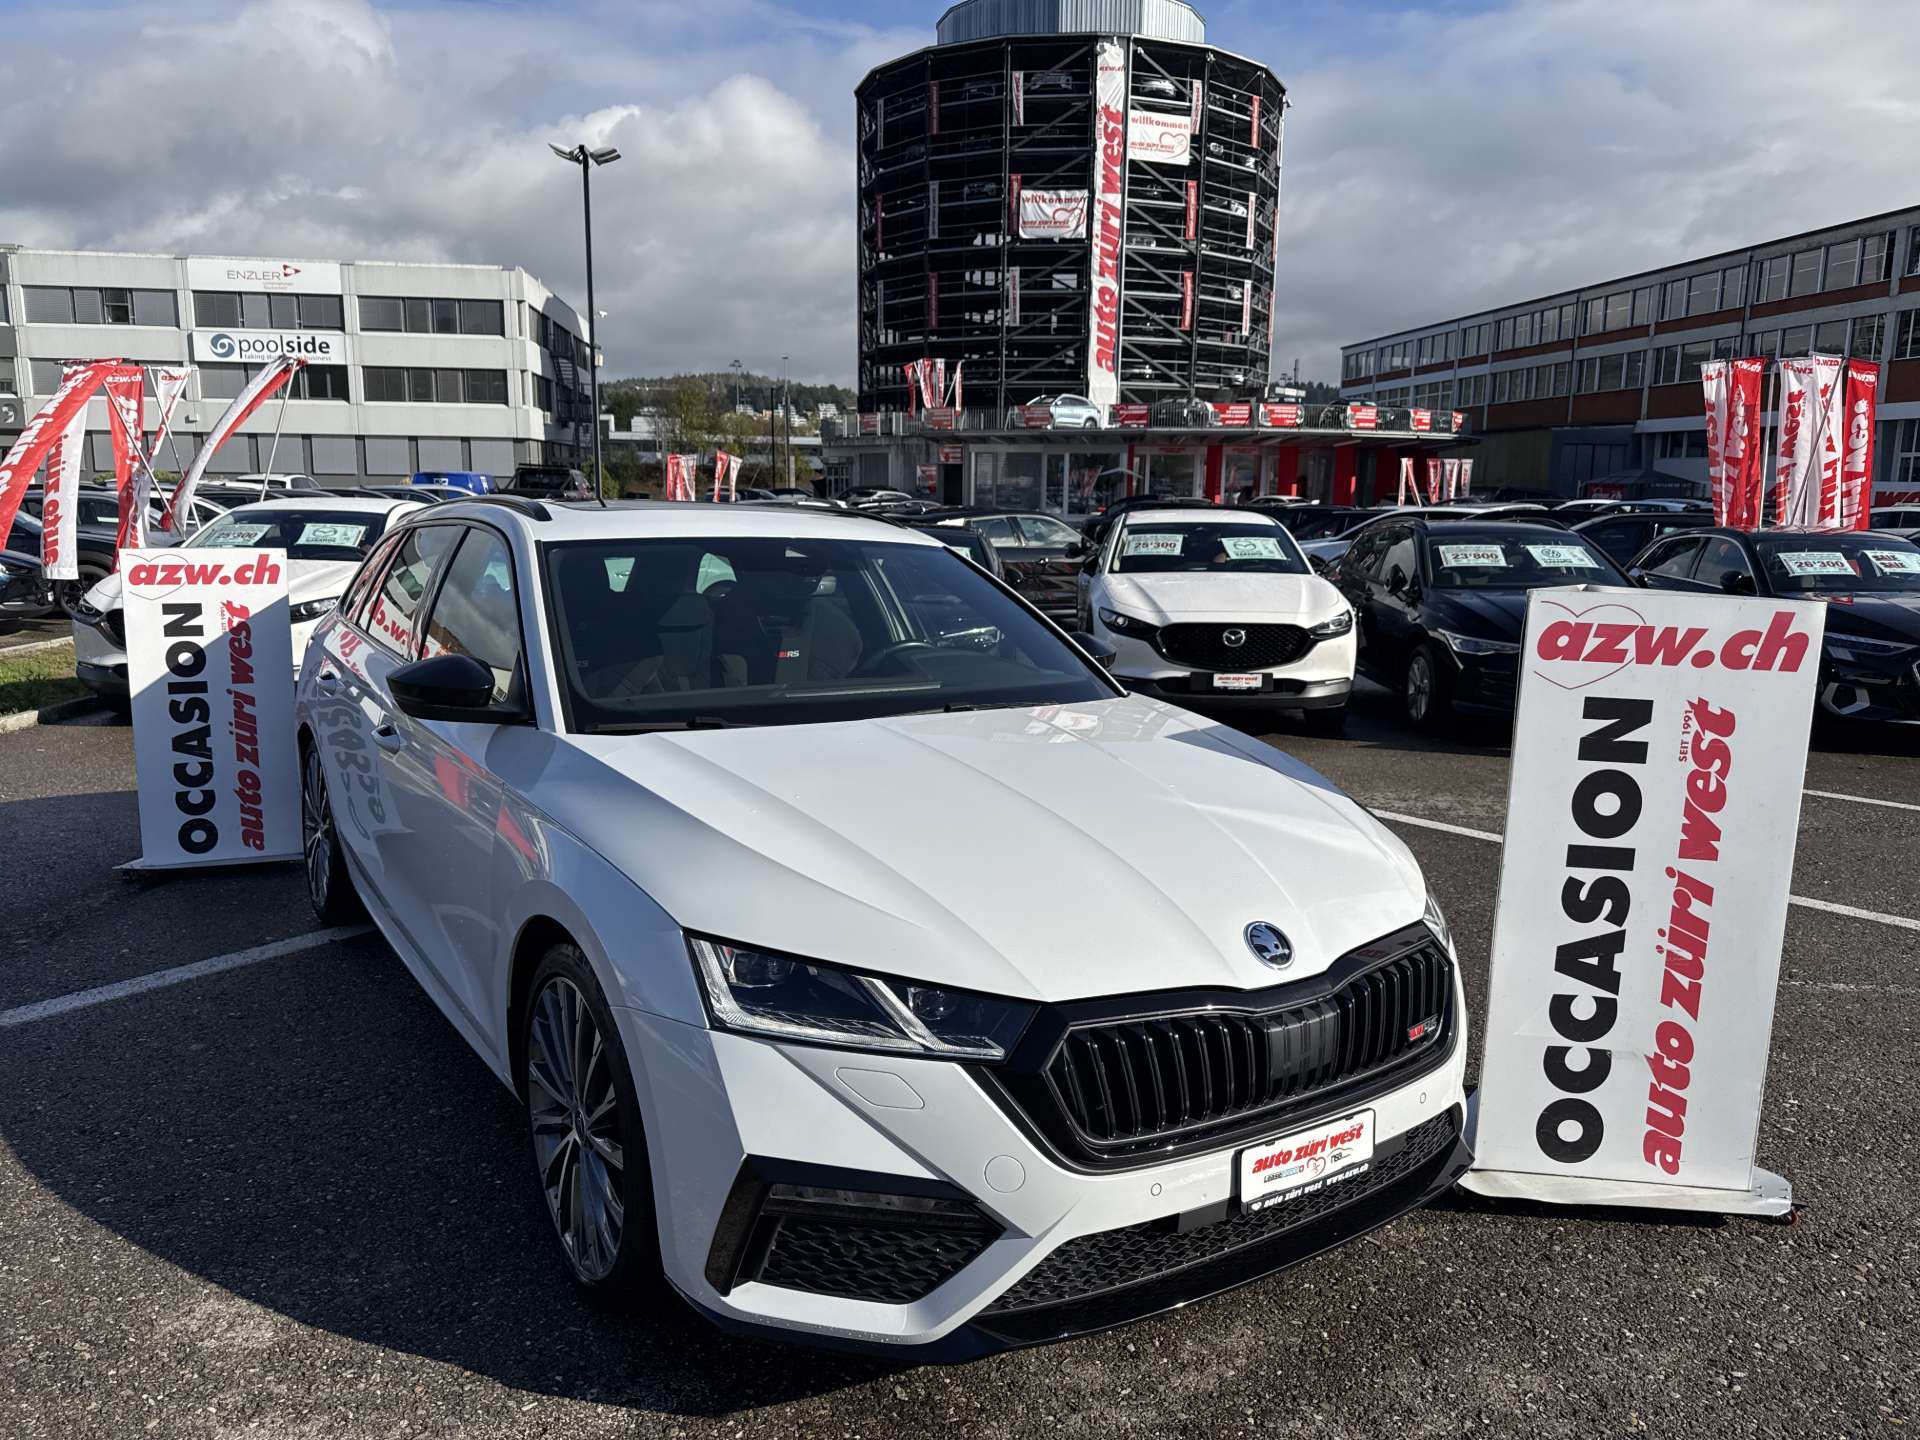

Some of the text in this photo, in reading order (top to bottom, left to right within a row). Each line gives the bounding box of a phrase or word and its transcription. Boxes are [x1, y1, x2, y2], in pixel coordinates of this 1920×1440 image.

[1131, 115, 1188, 130] willkommen
[1094, 103, 1124, 373] auto züri west
[227, 270, 281, 280] ENZLER
[238, 335, 331, 359] poolside
[106, 373, 142, 383] azw.ch
[128, 554, 281, 586] azw.ch
[1451, 552, 1499, 560] 23'800
[1795, 560, 1844, 568] 26'300
[1537, 611, 1809, 673] azw.ch
[162, 602, 218, 855] OCCASION
[225, 600, 265, 851] auto züri west
[1678, 708, 1694, 763] SEIT 1991
[1536, 696, 1654, 1164] OCCASION
[1642, 696, 1737, 1175] auto züri west
[1252, 1122, 1365, 1175] auto züri west
[1263, 1195, 1283, 1208] auto
[1284, 1187, 1304, 1200] züri
[1304, 1180, 1323, 1194] west
